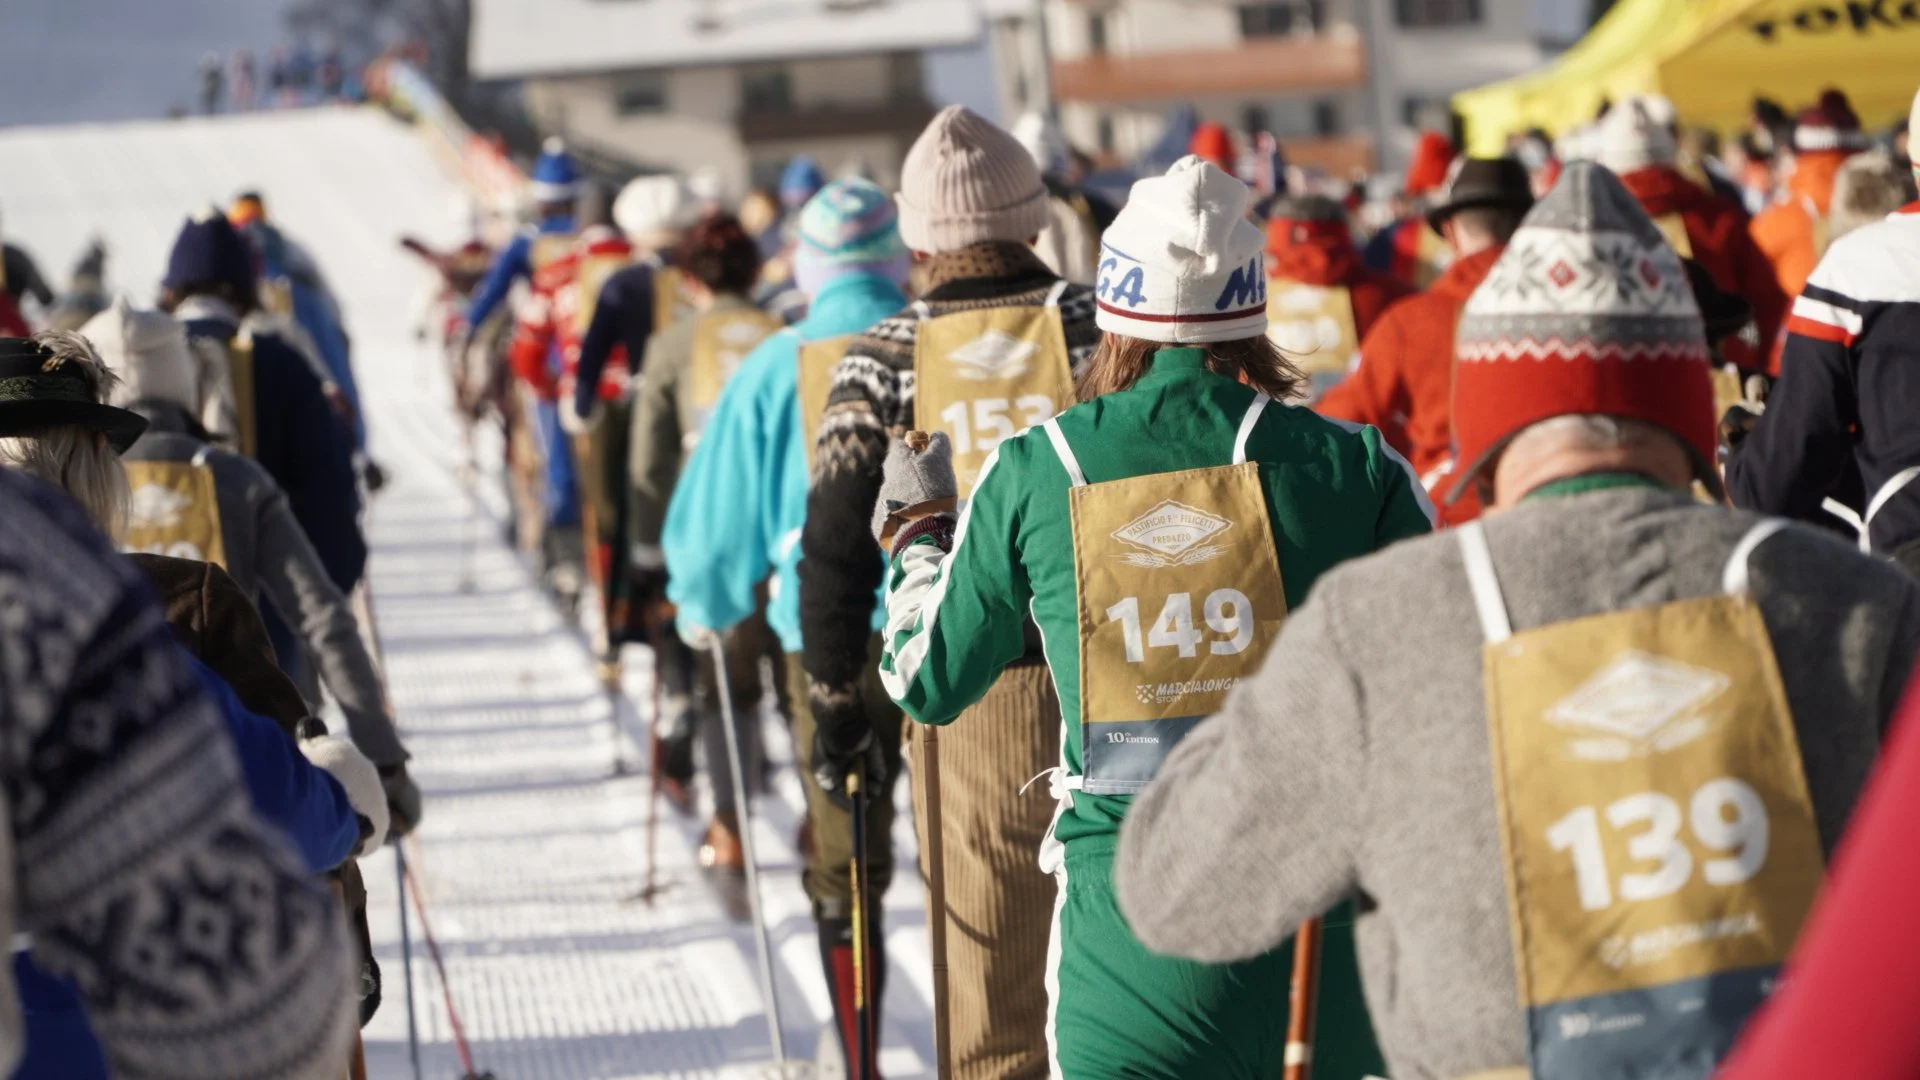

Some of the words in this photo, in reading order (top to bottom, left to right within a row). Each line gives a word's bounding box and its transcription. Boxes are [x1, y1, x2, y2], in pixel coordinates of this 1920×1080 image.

[940, 394, 1055, 455] 153
[1127, 515, 1166, 537] PASTIFICIO
[1180, 513, 1216, 530] FELICETTI
[1152, 532, 1191, 545] PREDAZZO
[1106, 588, 1254, 662] 149
[1126, 735, 1160, 744] EDITION
[1545, 777, 1770, 911] 139
